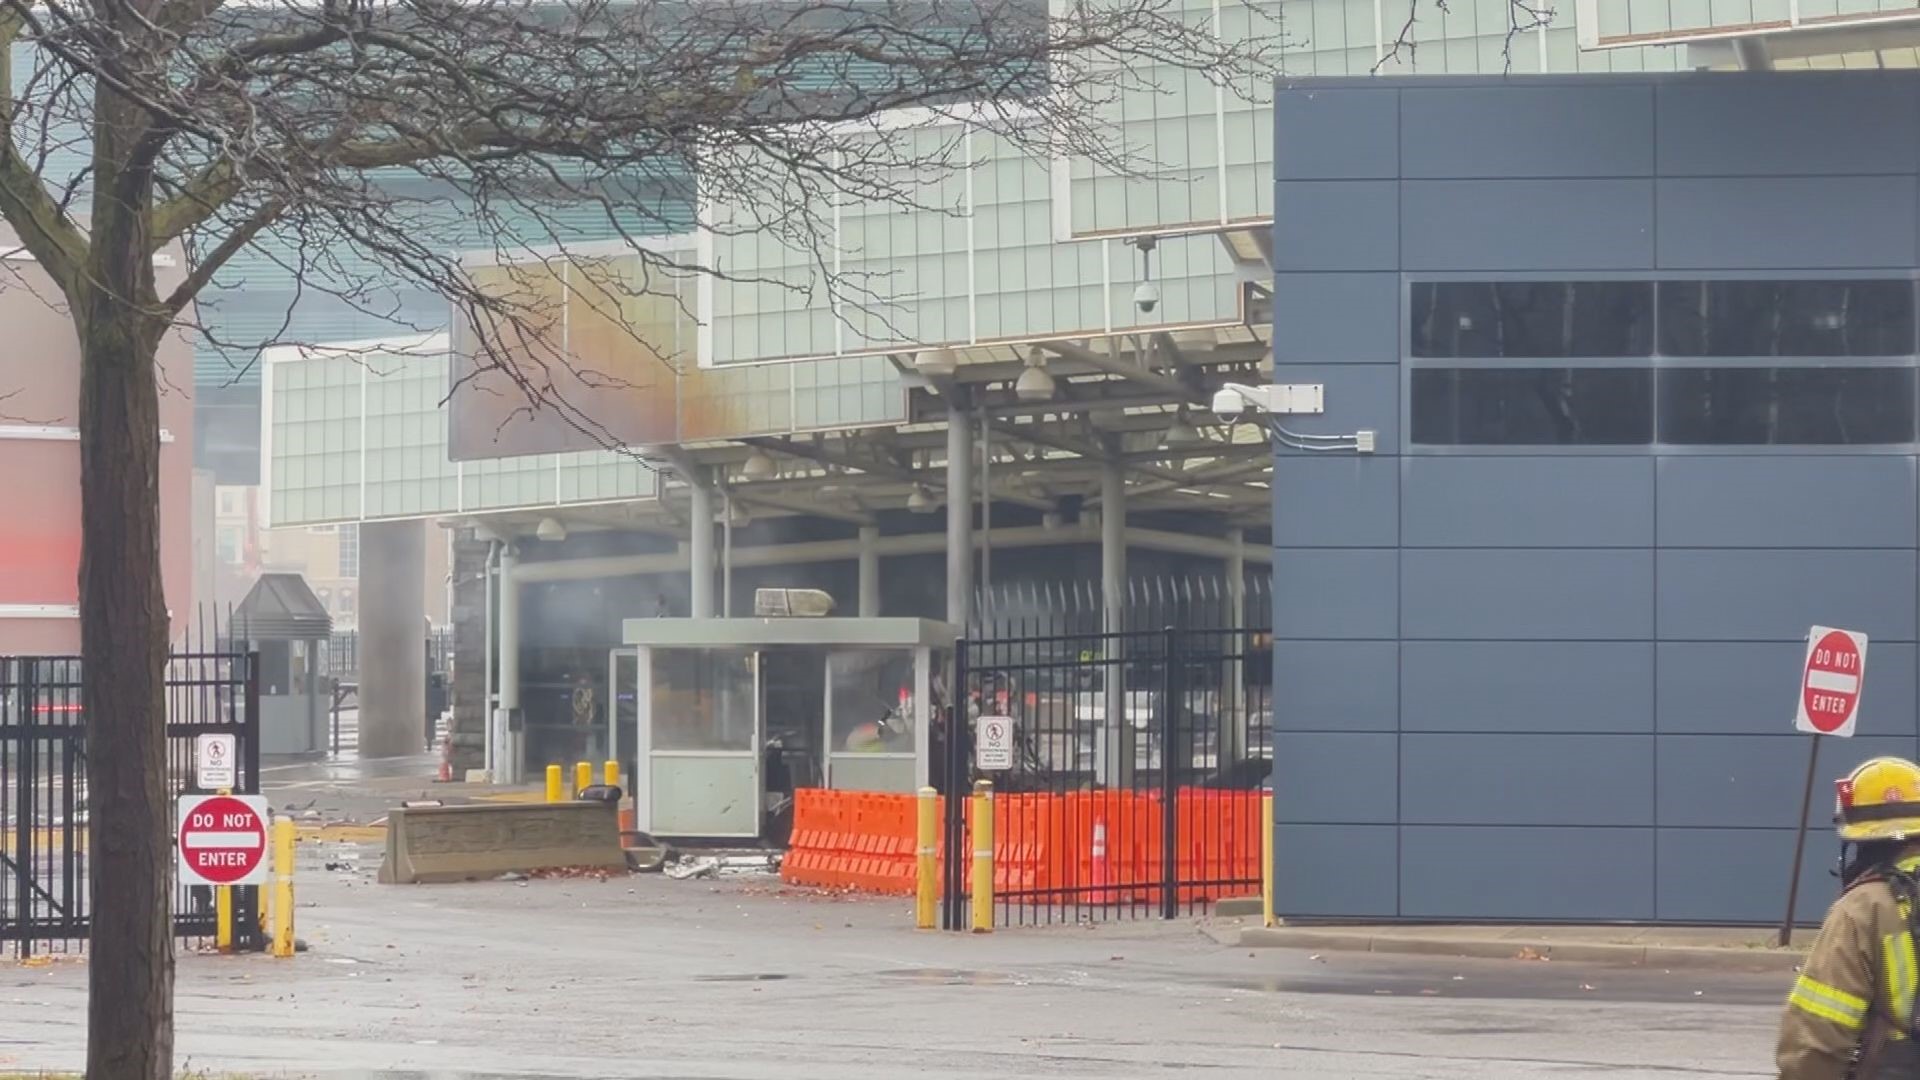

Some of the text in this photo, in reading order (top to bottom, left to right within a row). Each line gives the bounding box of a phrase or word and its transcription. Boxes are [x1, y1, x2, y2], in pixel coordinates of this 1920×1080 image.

[1816, 648, 1857, 669] DO NOT
[1812, 694, 1847, 714] ENTER
[193, 813, 253, 828] DO NOT
[198, 852, 247, 866] ENTER
